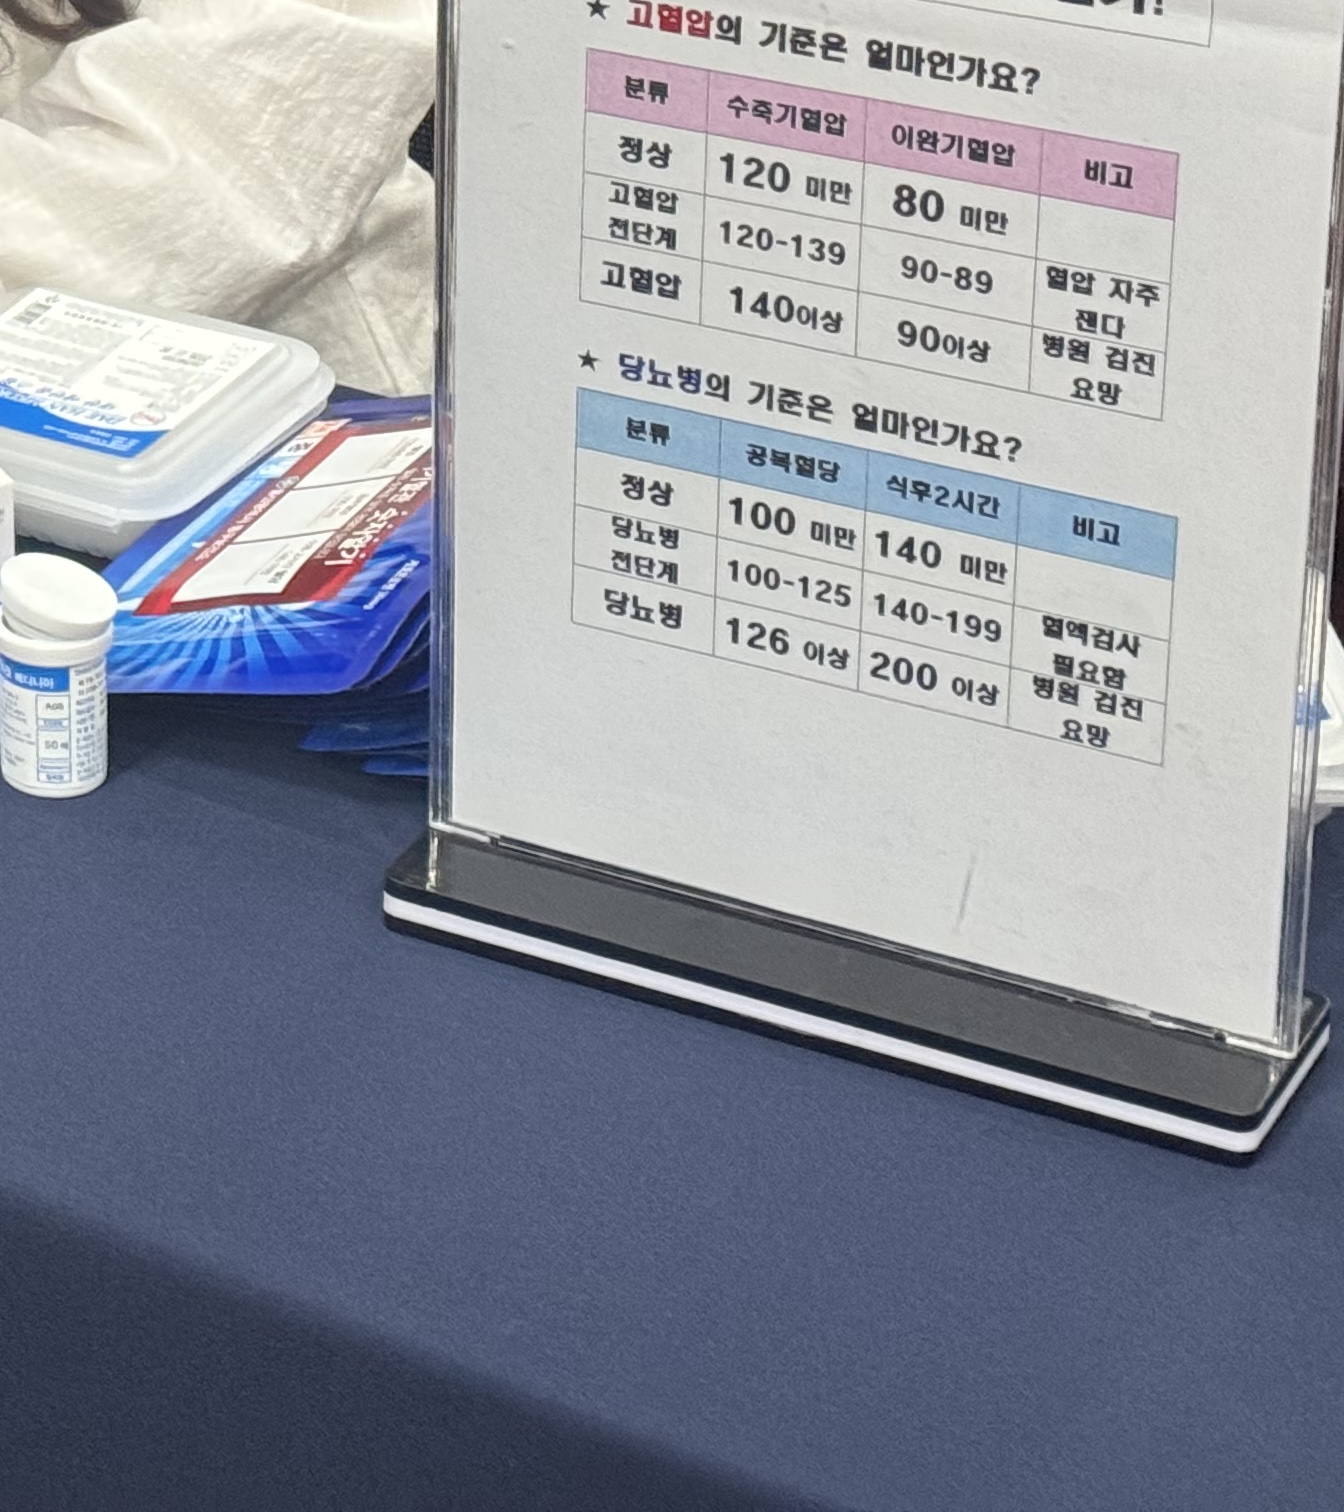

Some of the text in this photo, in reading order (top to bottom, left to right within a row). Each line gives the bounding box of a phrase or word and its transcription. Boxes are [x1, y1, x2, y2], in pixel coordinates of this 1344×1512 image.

[758, 20, 848, 63] 기준은
[865, 39, 1041, 96] 얼마인가요?
[624, 75, 669, 105] 분류
[727, 95, 848, 138] 수축기혈압
[618, 135, 673, 169] 정상
[891, 124, 1015, 167] 이완기혈압
[719, 153, 853, 206] 120 미만
[1084, 159, 1133, 190] 비고
[608, 180, 679, 215] 고혈압
[892, 184, 1009, 236] 80 미만
[608, 217, 677, 251] 전단계
[719, 220, 847, 266] 120-139
[599, 261, 682, 301] 고혈압
[900, 255, 994, 294] 90-89
[1046, 265, 1161, 308] 혈압 자주
[729, 286, 844, 334] 140이상
[897, 320, 991, 364] 90이상
[1042, 333, 1156, 377] 병원 검진
[618, 352, 1023, 462] 당뇨병의 기준은 얼마인가요?
[1070, 377, 1123, 406] 요망
[625, 416, 671, 447] 분류
[745, 443, 841, 484] 공복혈당
[620, 473, 674, 507] 정상
[885, 474, 1002, 519] 식후2시간
[611, 516, 680, 550] 당뇨병
[729, 497, 857, 551] 100 미만
[1072, 515, 1121, 547] 비고
[611, 549, 679, 585] 전단계
[874, 530, 1008, 585] 140 미만
[727, 560, 852, 607] 100-125
[604, 589, 683, 630] 당뇨병
[873, 593, 1002, 642] 140-199
[726, 618, 851, 670] 126 이상
[1042, 615, 1141, 658] 혈액검사
[869, 651, 1000, 707] 200 이상
[1053, 653, 1126, 690] 필요함
[1032, 675, 1144, 722] 병원 검진
[1059, 719, 1111, 749] 요망
